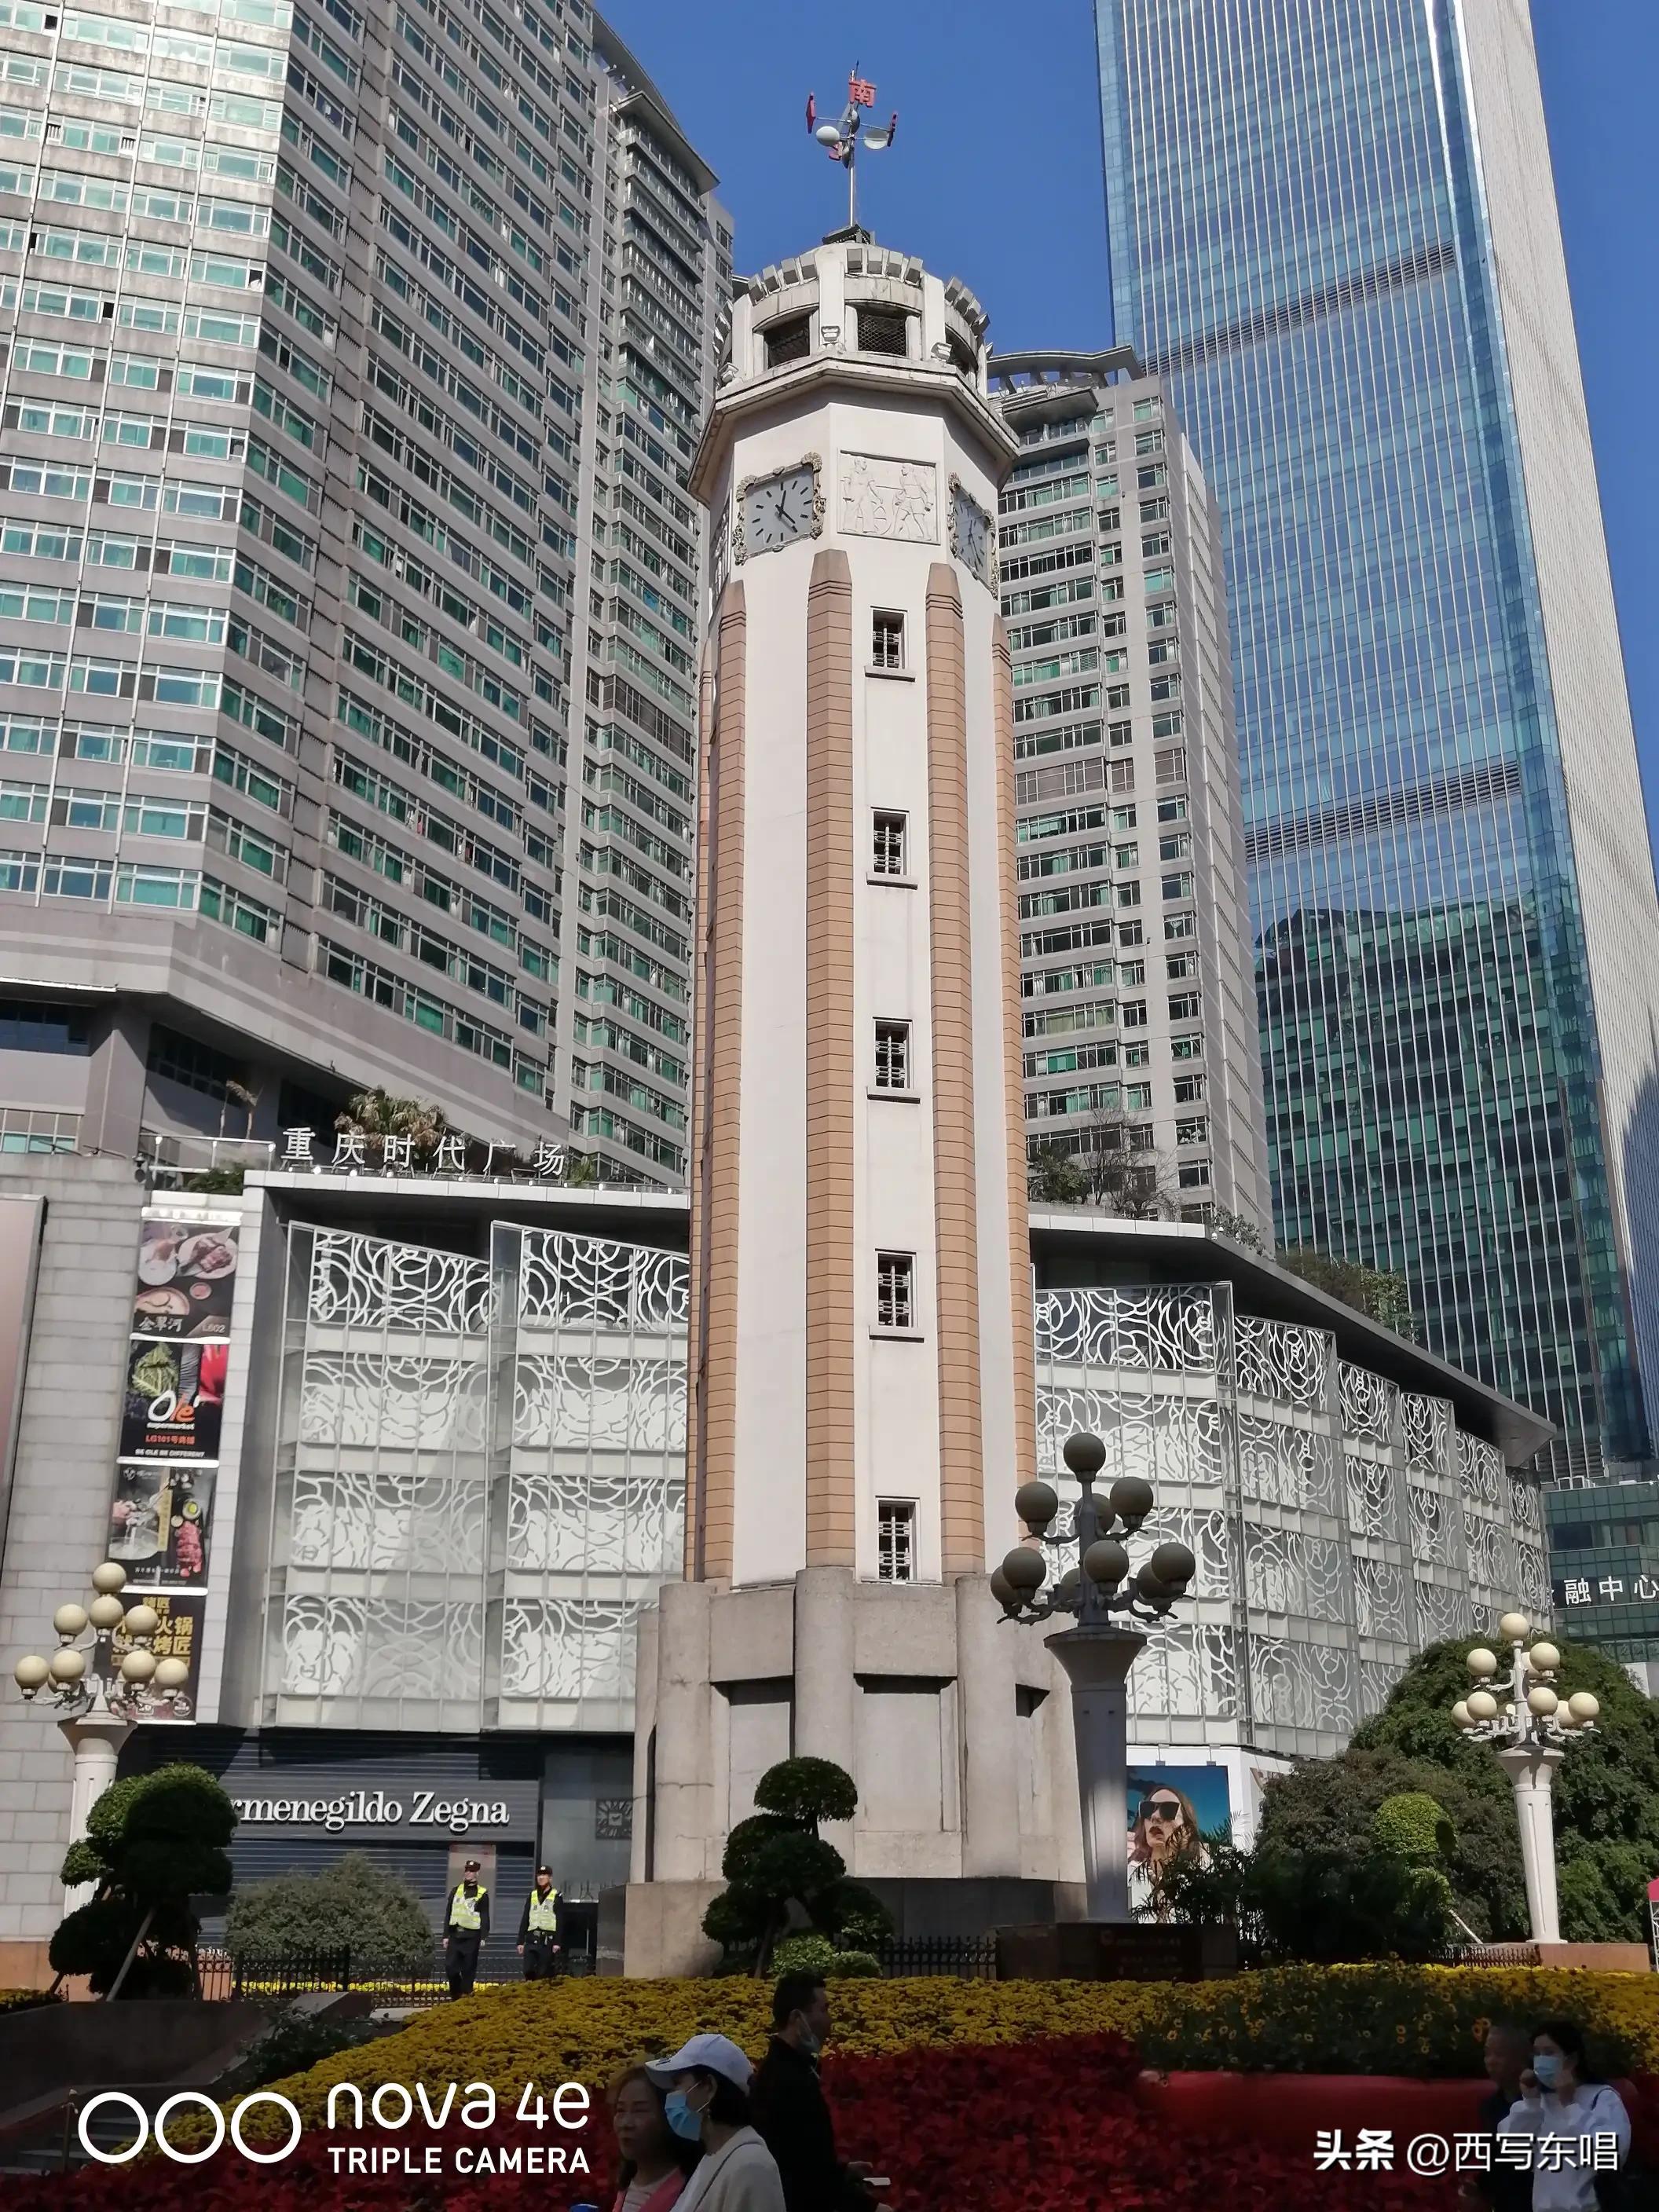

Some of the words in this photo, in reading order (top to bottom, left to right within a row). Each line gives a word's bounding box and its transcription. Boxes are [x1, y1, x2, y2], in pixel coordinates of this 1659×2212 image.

[280, 1126, 566, 1176] 重庆时代广场
[1551, 1574, 1659, 1605] 融中心
[409, 1791, 510, 1832] Zegna
